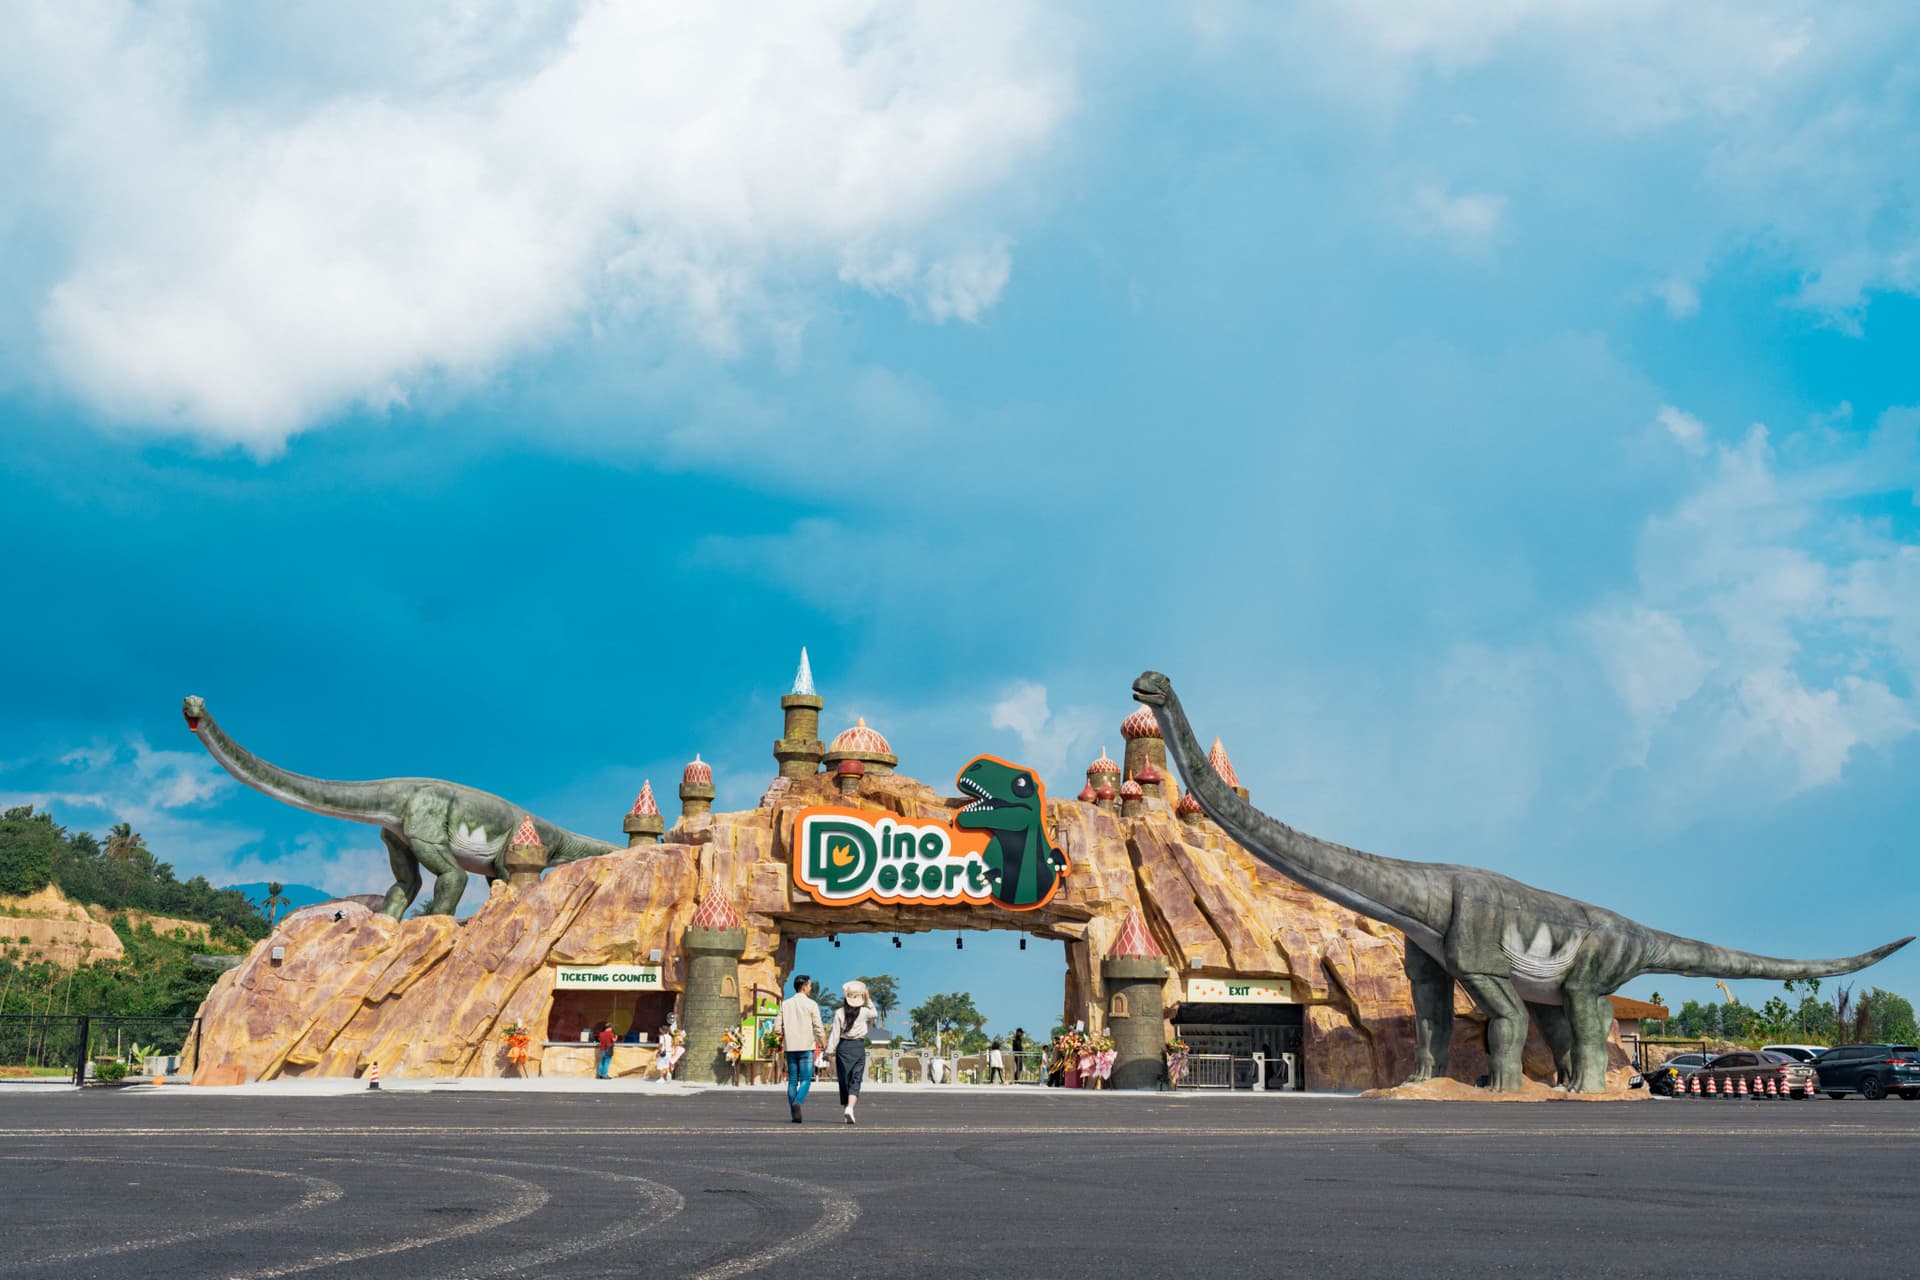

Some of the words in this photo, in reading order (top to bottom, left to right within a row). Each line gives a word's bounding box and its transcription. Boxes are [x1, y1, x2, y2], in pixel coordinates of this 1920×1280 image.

[809, 821, 944, 892] Dino
[561, 973, 609, 982] TICKETING
[612, 974, 657, 983] COUNTER
[1229, 986, 1250, 996] EXIT
